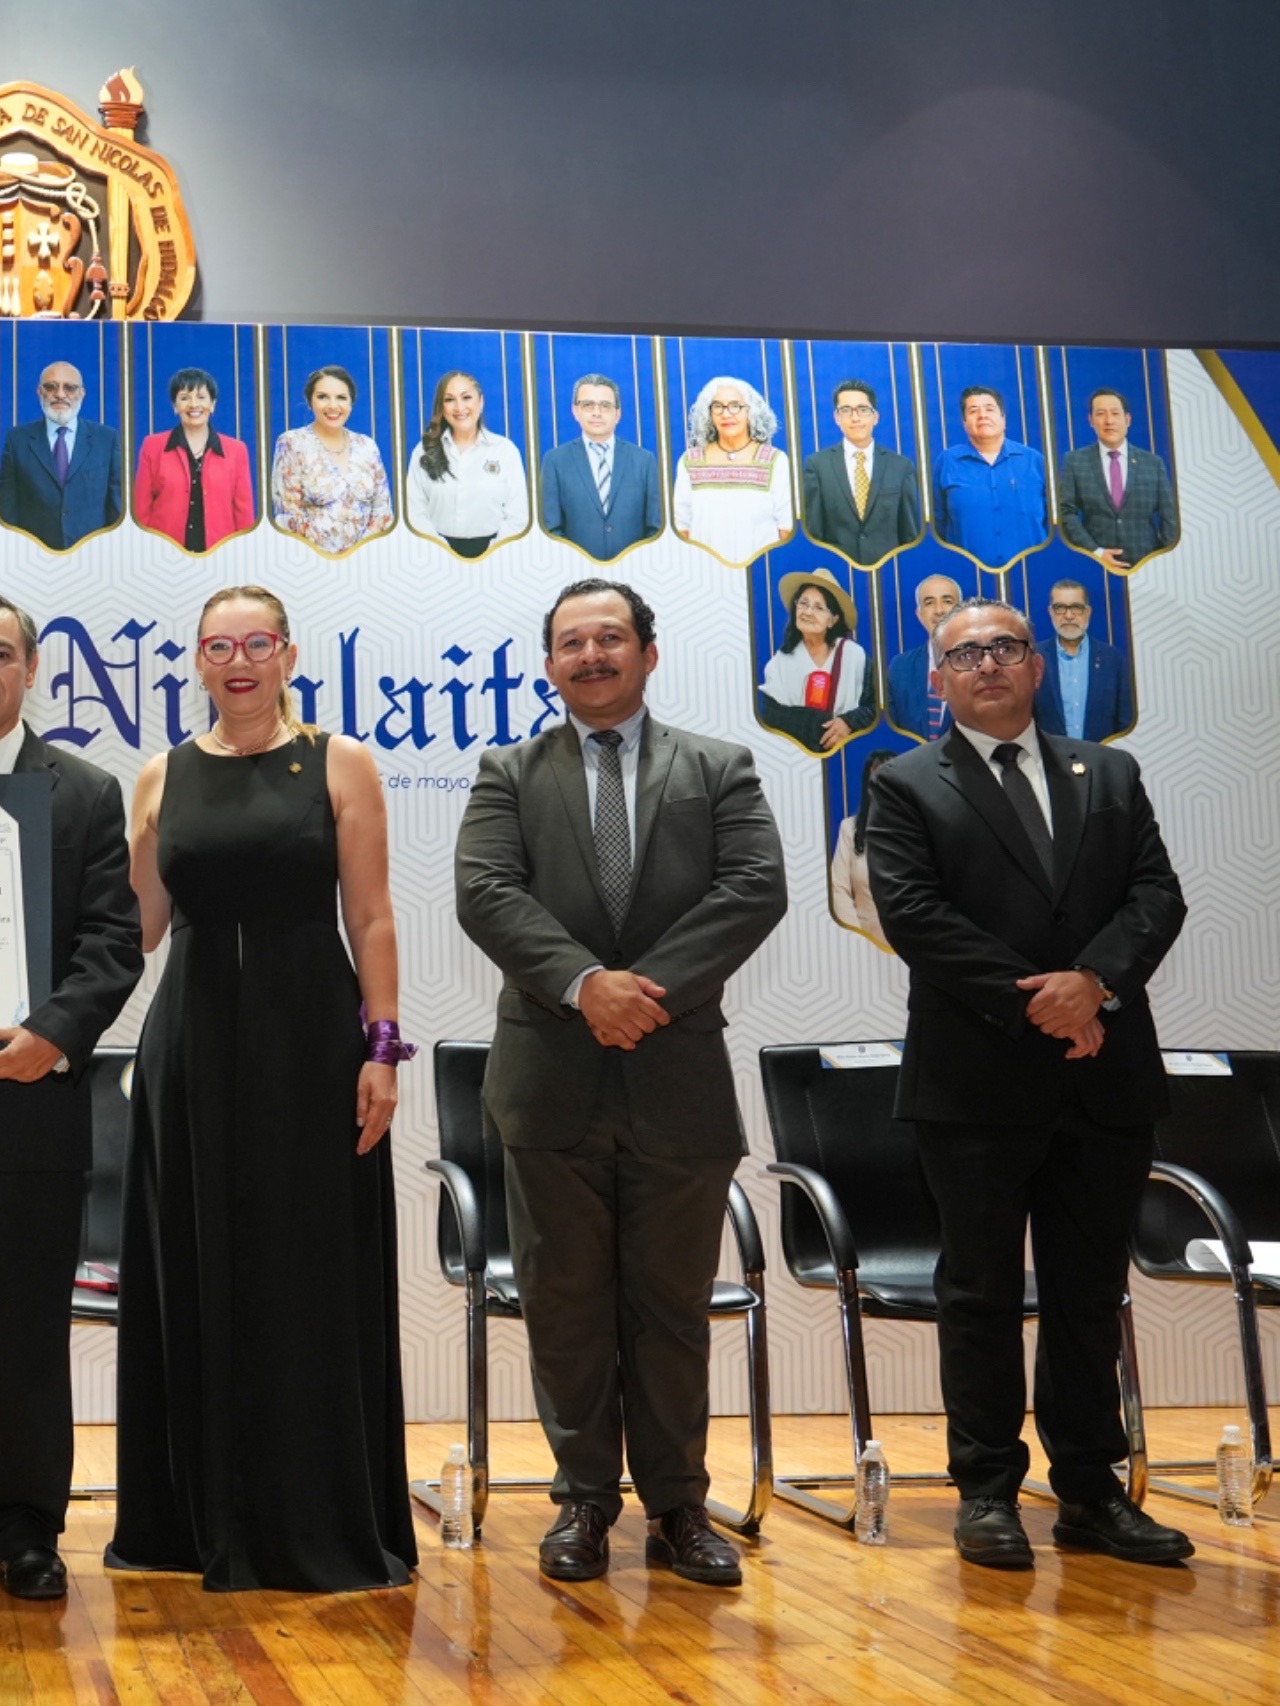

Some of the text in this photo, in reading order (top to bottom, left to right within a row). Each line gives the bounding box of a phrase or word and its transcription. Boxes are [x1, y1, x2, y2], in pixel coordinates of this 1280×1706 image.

[22, 102, 46, 126] DE
[52, 116, 90, 150] SAN
[89, 138, 165, 199] NICOLAS
[149, 205, 172, 235] DE
[388, 774, 412, 789] de
[416, 776, 470, 793] mayo
